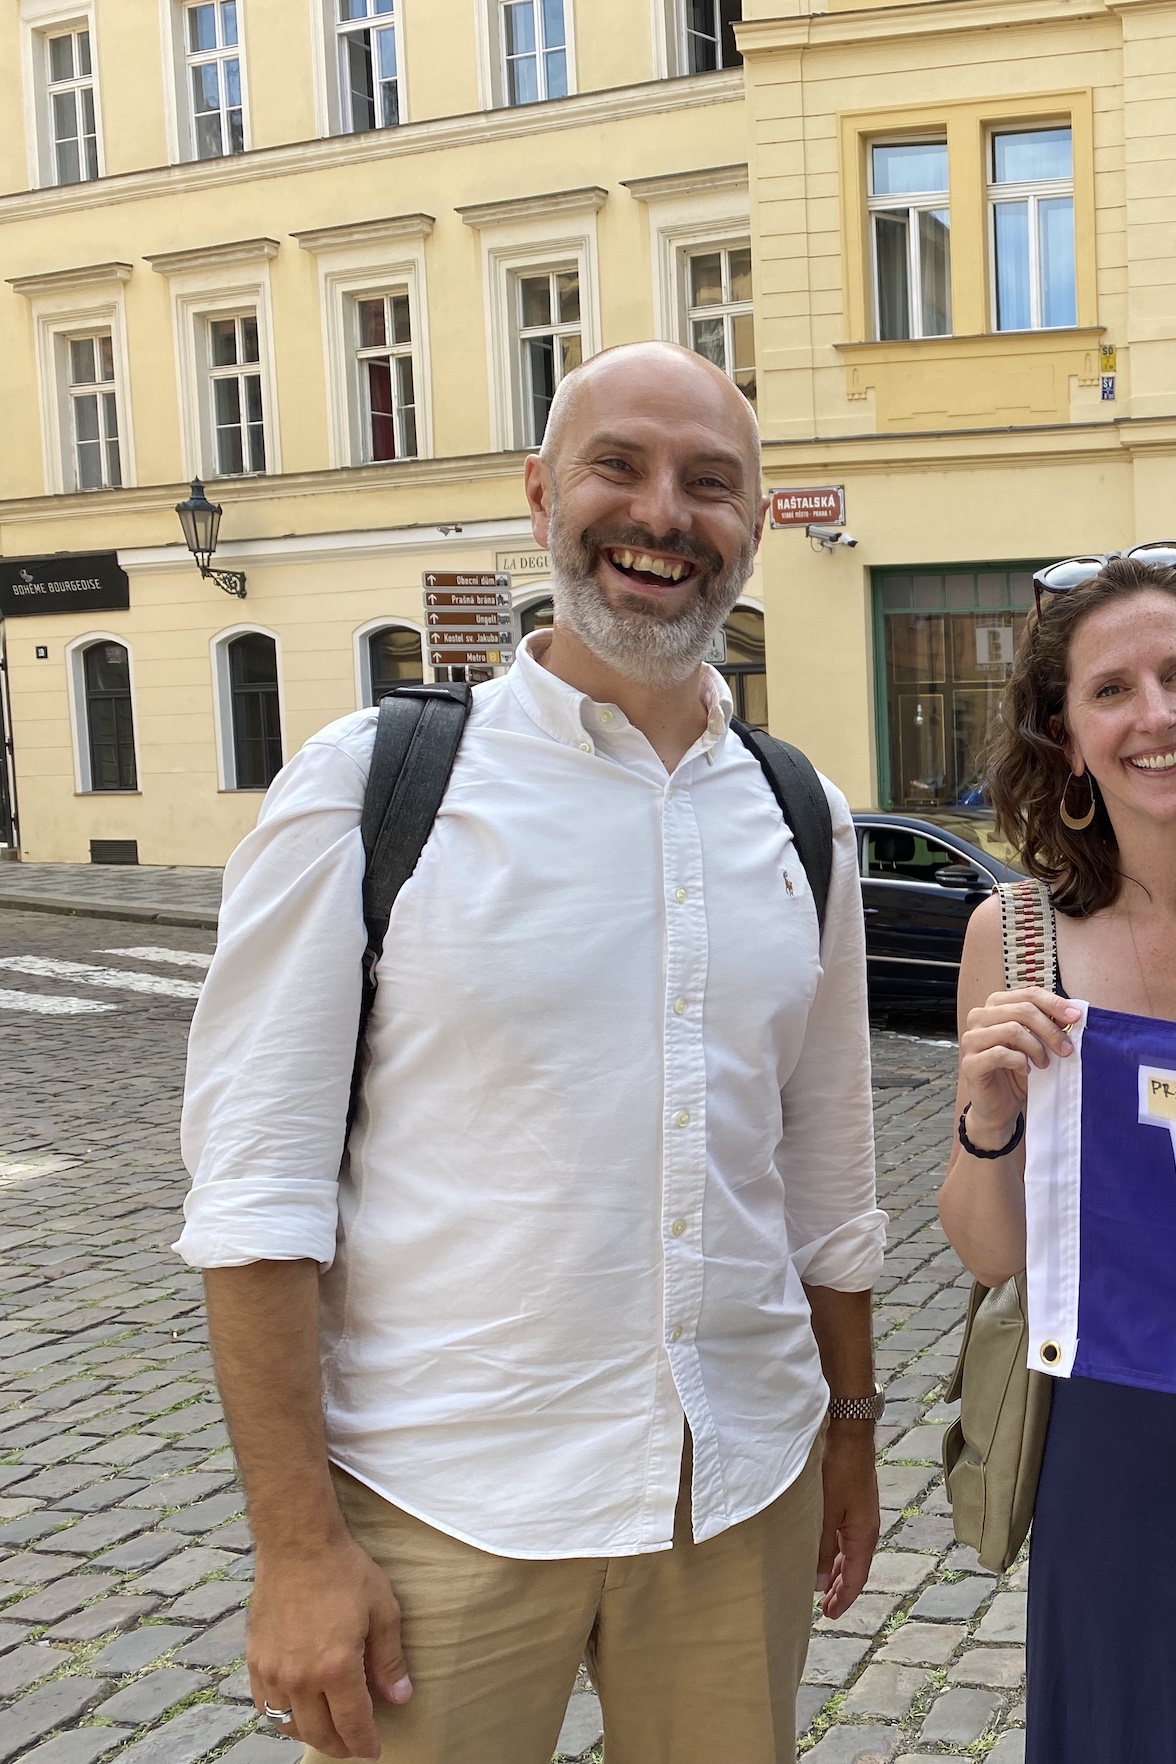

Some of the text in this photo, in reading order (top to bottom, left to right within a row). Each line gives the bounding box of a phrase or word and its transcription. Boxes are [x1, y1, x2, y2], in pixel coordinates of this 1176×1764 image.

[777, 494, 835, 510] HAŠTALSKÁ
[503, 558, 517, 570] LA
[456, 575, 495, 586] Obecní dům
[12, 579, 102, 595] BOHÊME BOURGEOISE
[451, 594, 496, 604] Prašná brána
[475, 614, 497, 626] Ungelt
[443, 632, 499, 643] Kostel sv. Jakuba
[466, 654, 486, 662] Metro
